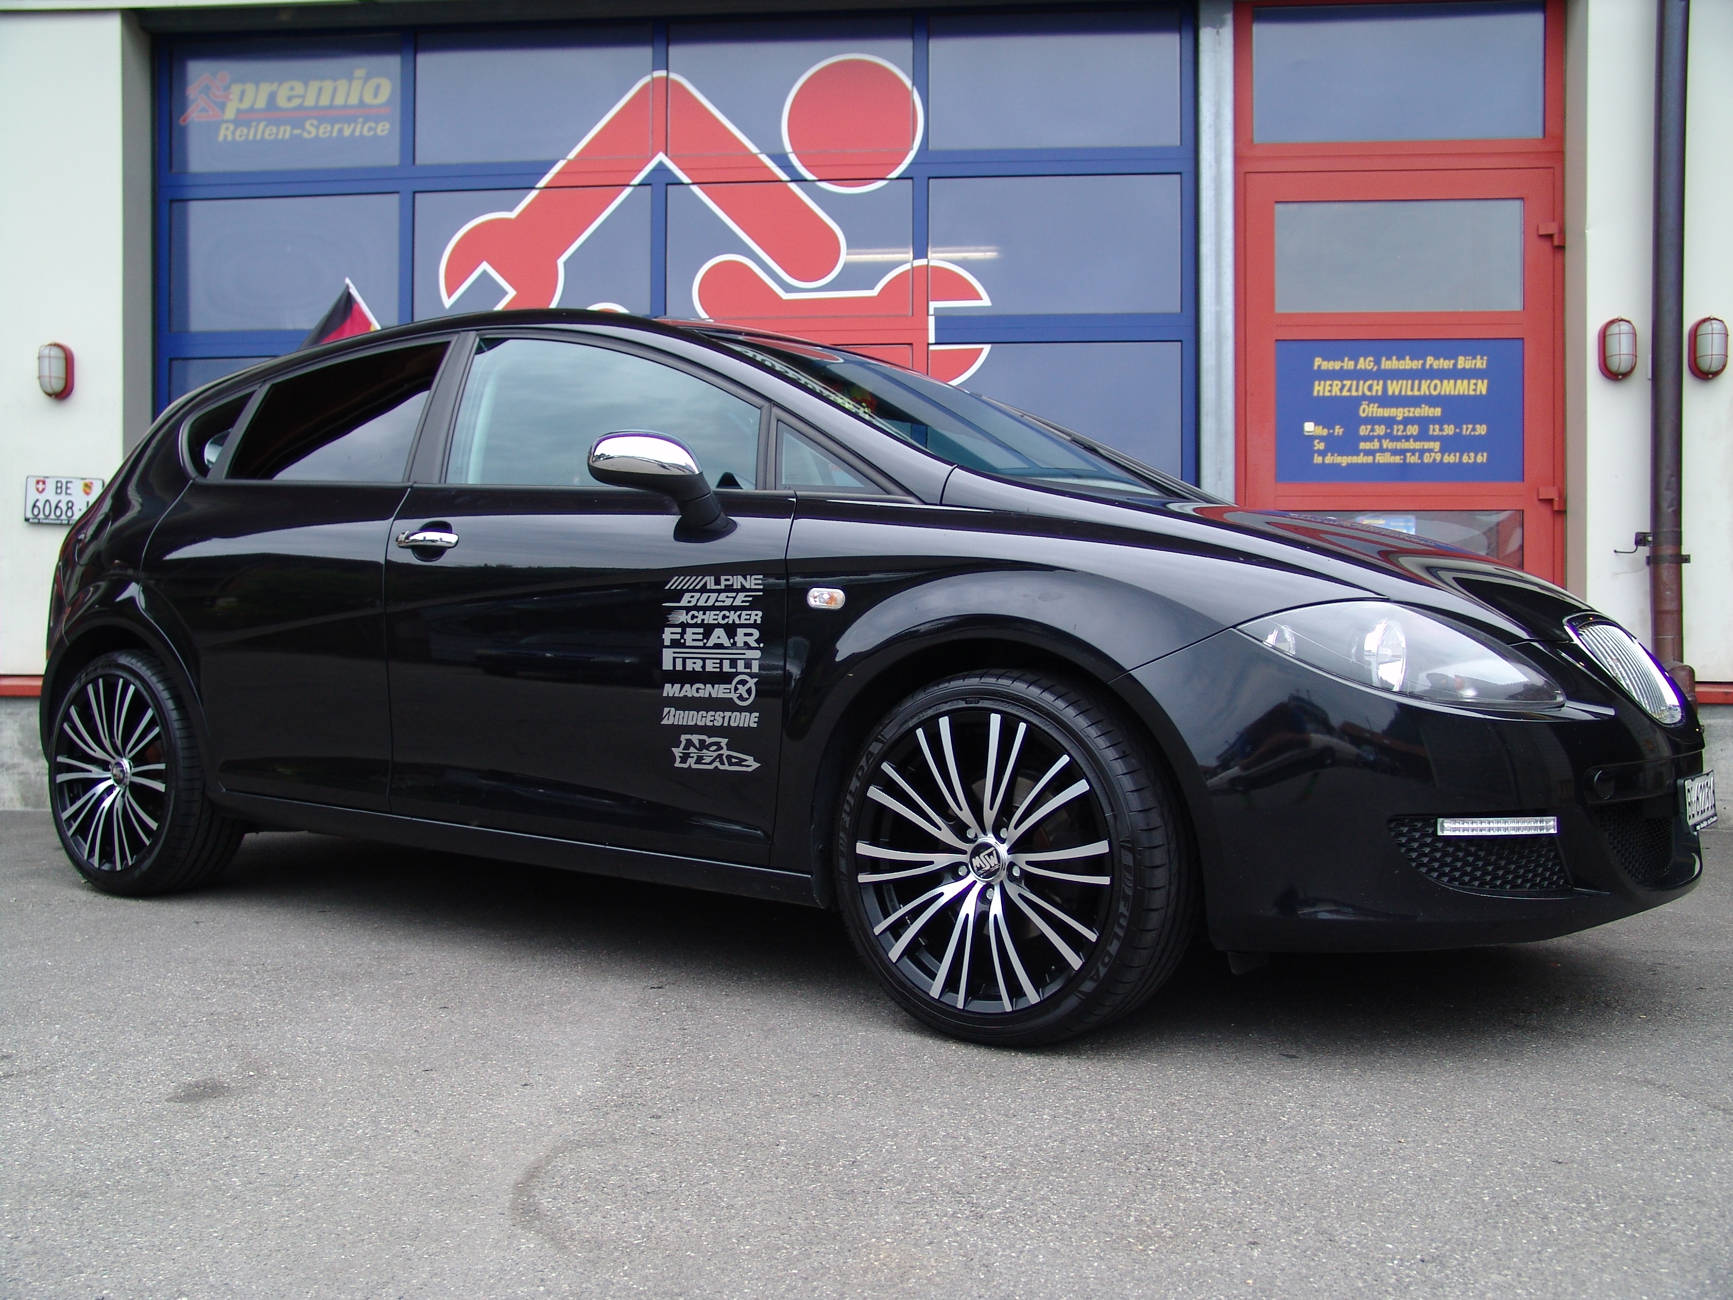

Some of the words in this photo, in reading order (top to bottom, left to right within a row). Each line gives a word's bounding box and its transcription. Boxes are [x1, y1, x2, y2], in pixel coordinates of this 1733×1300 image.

[224, 68, 392, 120] premio
[218, 118, 391, 142] Reifen-Service
[1357, 356, 1378, 371] AG,
[1381, 355, 1424, 370] Inhaber
[1426, 356, 1455, 369] Peter
[1458, 355, 1488, 369] Bürki
[1313, 380, 1383, 396] HERZLICH
[1387, 379, 1488, 395] WILLKOMMEN
[1359, 401, 1442, 420] Öffnungszeiten
[1314, 425, 1328, 436] Mo
[1334, 425, 1344, 436] Fr
[1360, 424, 1386, 435] 07.30
[1393, 424, 1419, 435] 12.00
[1429, 424, 1455, 435] 13.30
[1462, 424, 1487, 435] 17.30
[1313, 439, 1325, 450] Sa
[1359, 438, 1380, 449] nach
[1382, 438, 1440, 452] Vereinbarung
[1313, 453, 1323, 464] In
[1324, 452, 1373, 466] dringenden
[1406, 452, 1421, 463] Tel.
[1423, 452, 1441, 463] 079
[1443, 452, 1460, 463] 661
[1462, 452, 1475, 463] 63
[1476, 452, 1487, 463] 61
[55, 480, 73, 496] BE
[693, 575, 764, 590] ALPINE
[662, 592, 763, 607] BOSE
[686, 610, 763, 624] CHECKER
[662, 648, 762, 673] PIRELLI
[662, 674, 759, 707] MAGNEX
[660, 707, 760, 728] BRIDGESTONE
[681, 735, 727, 753] NO
[674, 750, 758, 770] FEAR
[971, 846, 1000, 873] MSW
